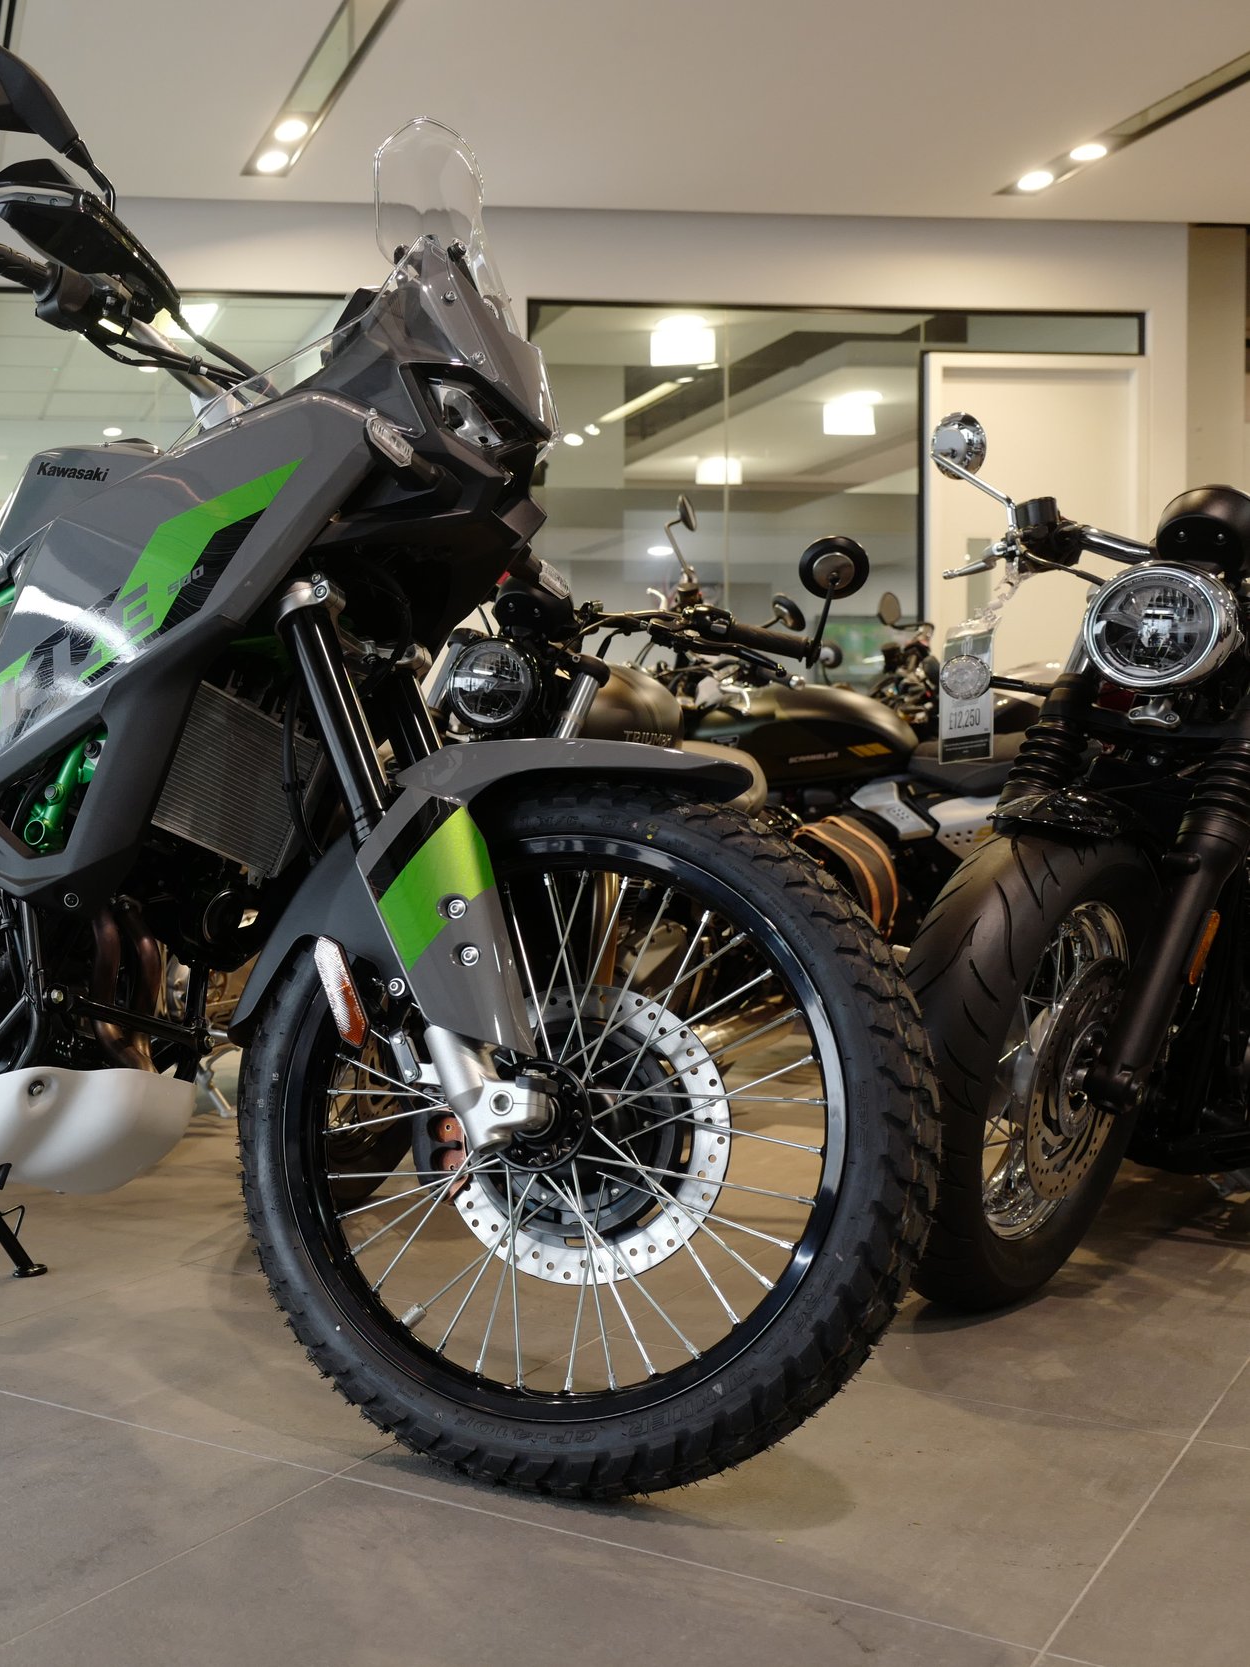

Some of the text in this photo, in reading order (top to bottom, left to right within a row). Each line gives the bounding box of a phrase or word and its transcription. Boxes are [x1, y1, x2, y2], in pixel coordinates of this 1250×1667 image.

[36, 461, 110, 482] Kawasaki
[167, 564, 204, 596] 500
[948, 707, 981, 731] £12,250
